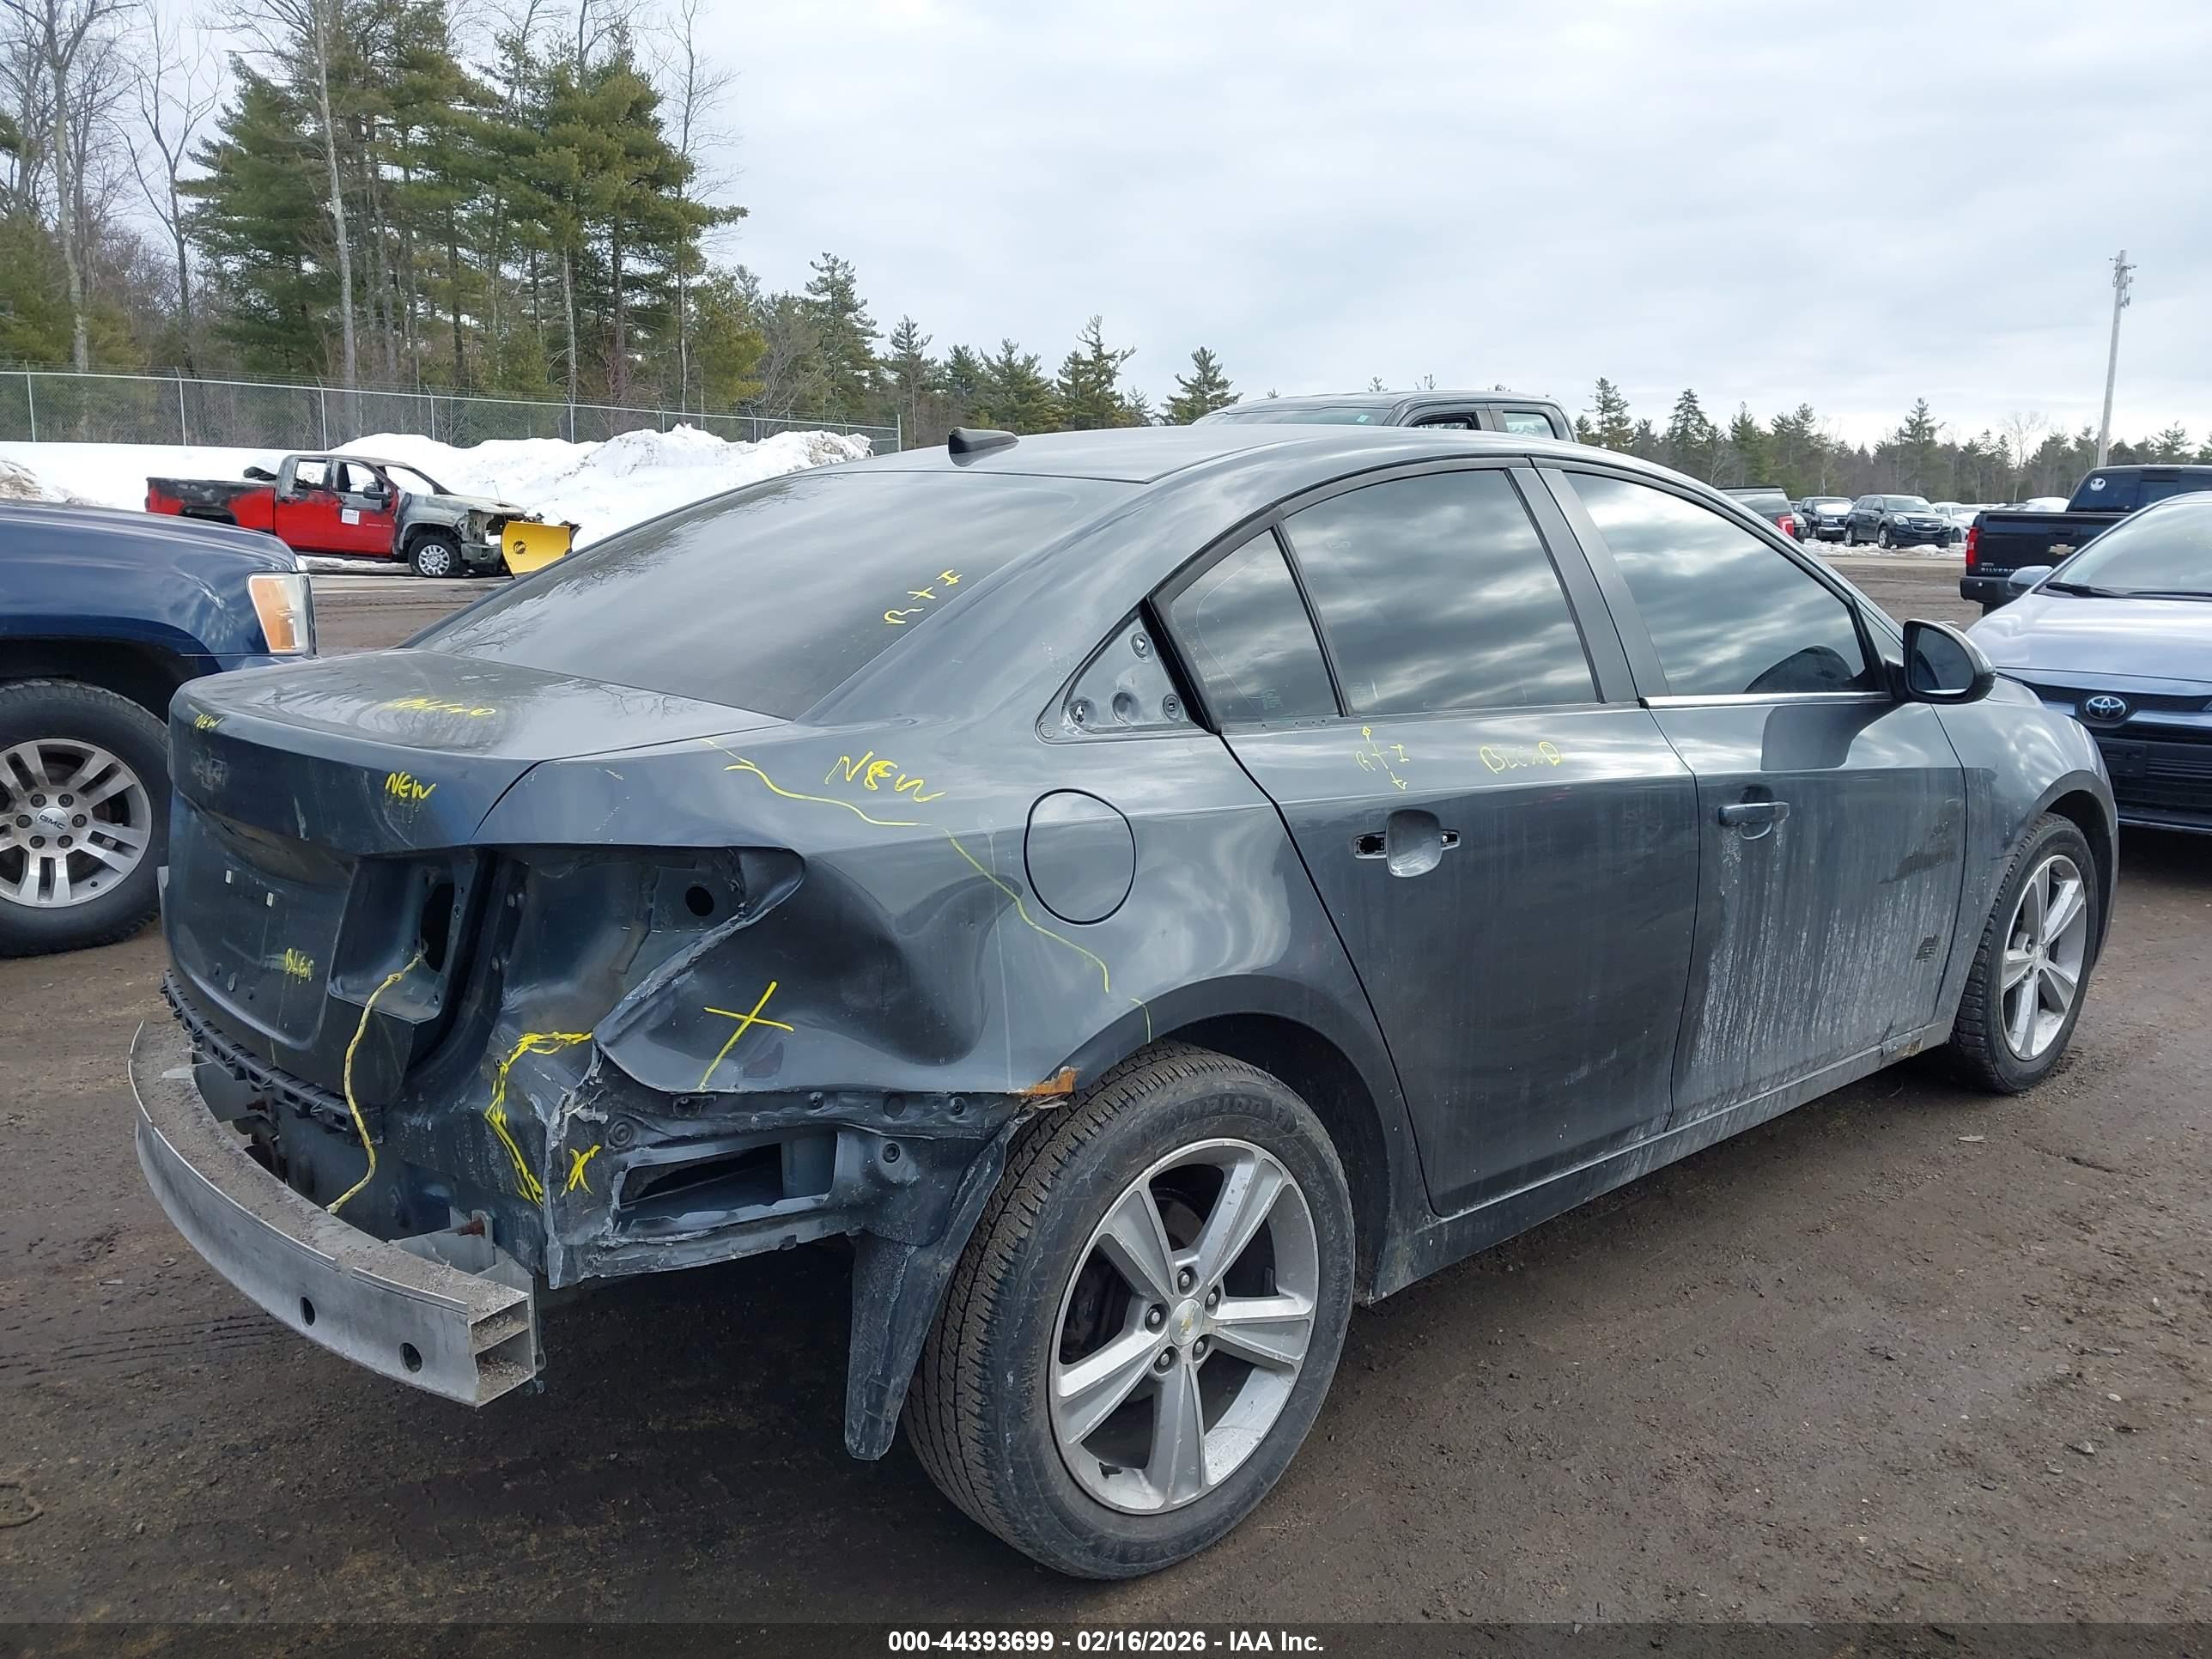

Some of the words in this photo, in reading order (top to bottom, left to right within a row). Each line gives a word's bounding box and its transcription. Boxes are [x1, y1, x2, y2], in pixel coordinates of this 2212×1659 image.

[385, 771, 437, 799] NEW
[824, 750, 947, 803] NEW
[40, 814, 66, 830] GMC
